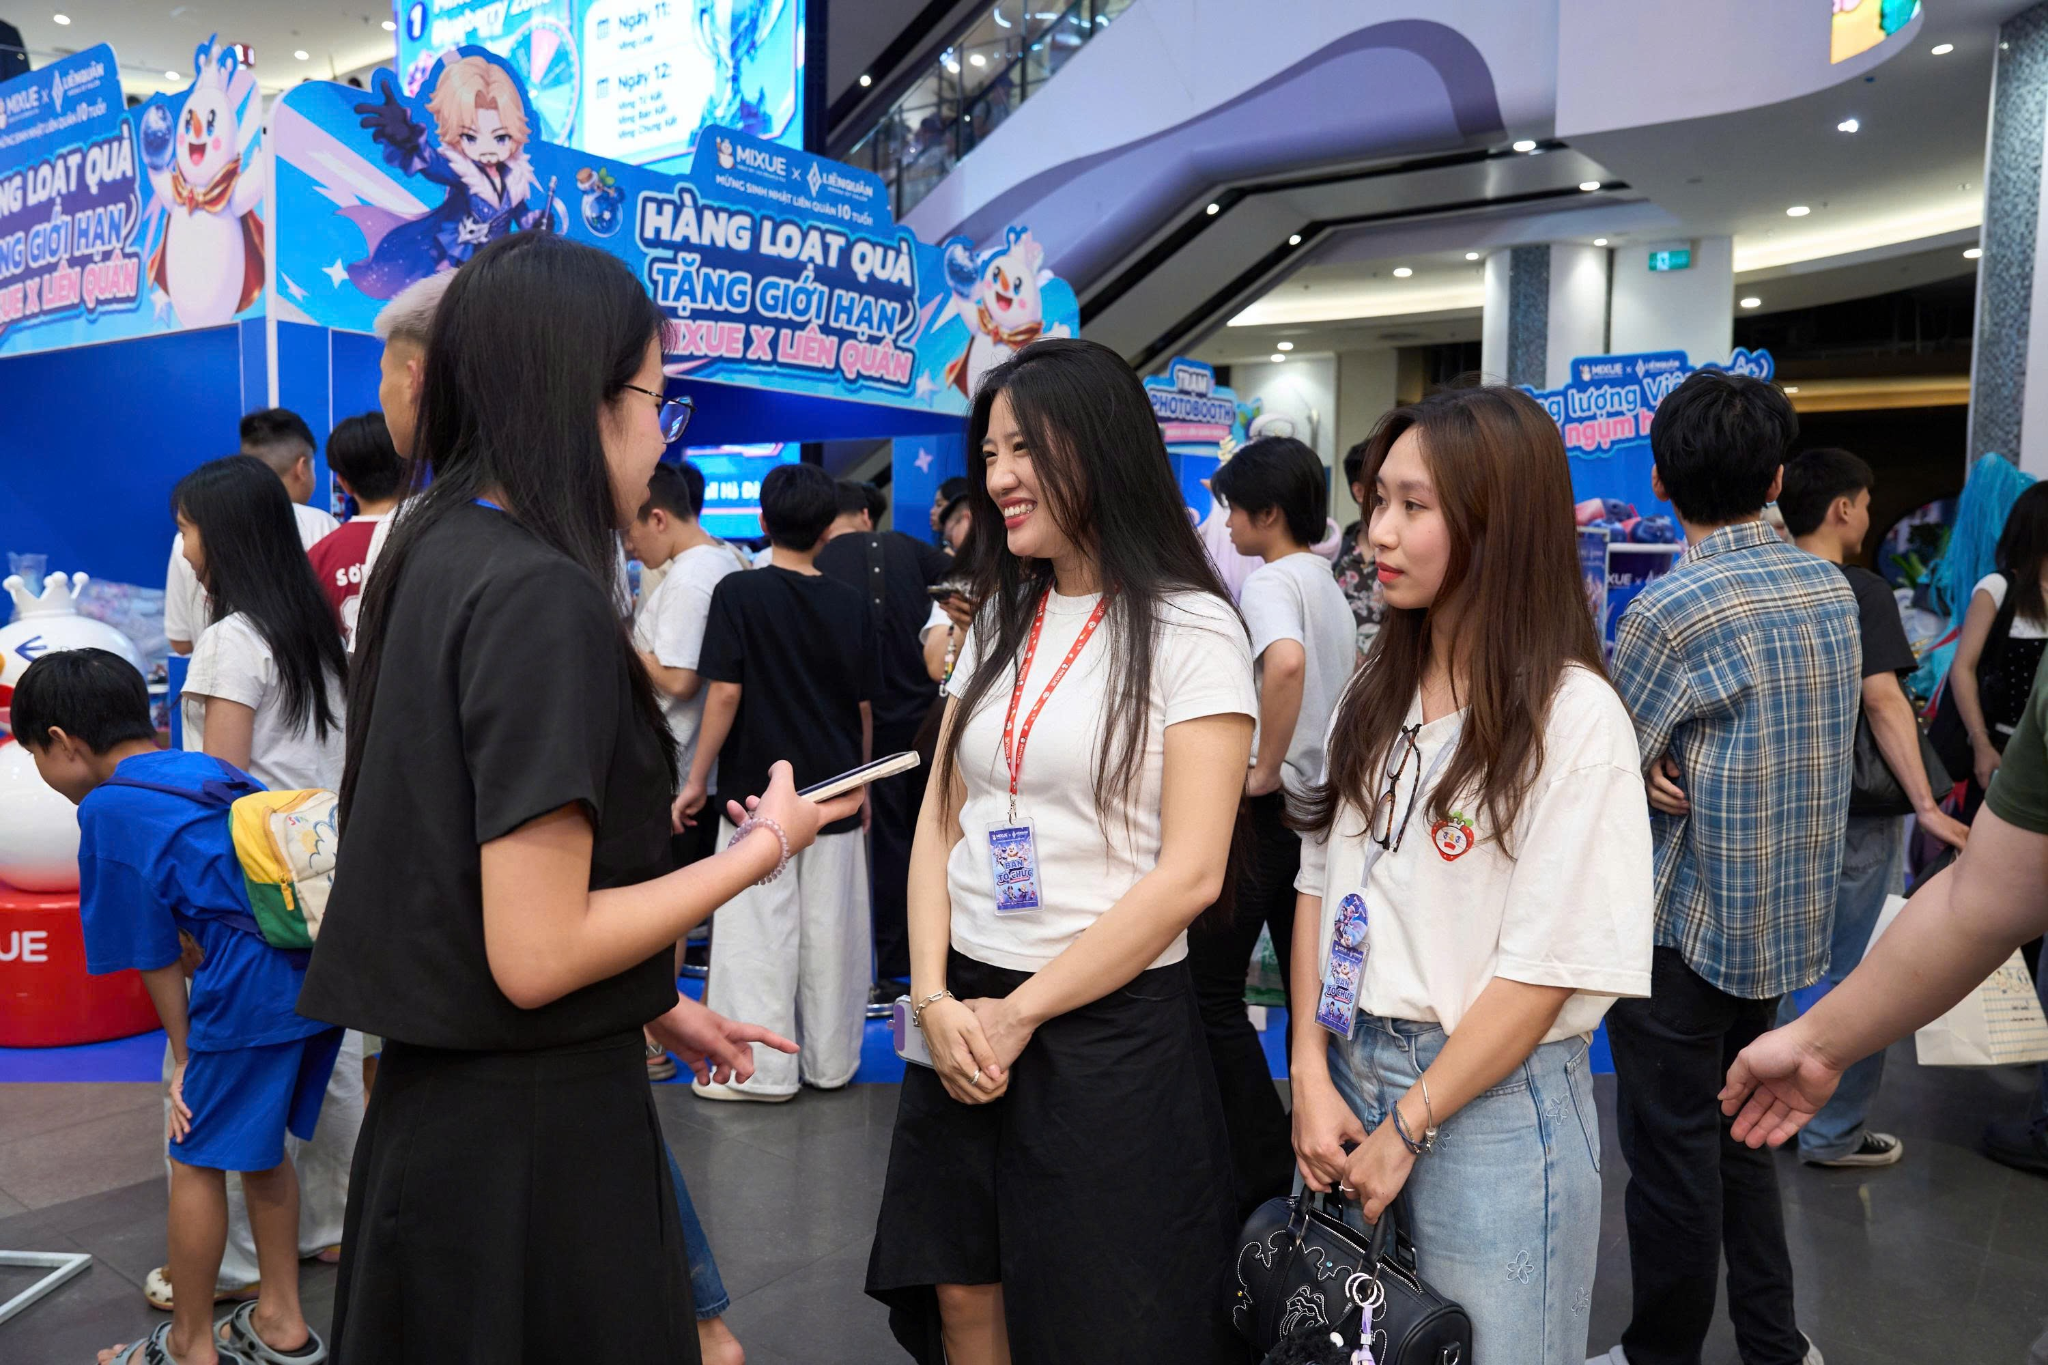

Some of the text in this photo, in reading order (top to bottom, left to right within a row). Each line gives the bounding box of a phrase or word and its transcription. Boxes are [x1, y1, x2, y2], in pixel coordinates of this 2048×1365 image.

[409, 3, 423, 38] 1
[26, 151, 83, 207] LOẠT
[85, 123, 134, 195] QUÀ
[736, 145, 787, 176] MIXUE
[715, 174, 745, 192] MỪNG
[746, 182, 768, 198] SINH
[768, 187, 792, 206] NHẬT
[792, 195, 812, 210] LIÊN
[812, 200, 837, 216] QUÂN
[837, 203, 851, 221] 10
[27, 200, 72, 268] GIỚI
[73, 202, 126, 262] HẠN
[643, 192, 913, 288] HÀNG LOẠT QUÀ
[24, 277, 41, 315] X
[42, 258, 81, 310] LIÊN
[82, 248, 139, 309] QUÂN
[651, 252, 901, 341] TẶNG GIỚI HẠN
[664, 317, 914, 384] IXUE X LIÊN QUÂN
[1591, 361, 1623, 377] MIXUE
[1151, 392, 1233, 424] PHOTOBOOTH
[1567, 386, 1640, 419] lượng
[1565, 415, 1635, 450] ngụm
